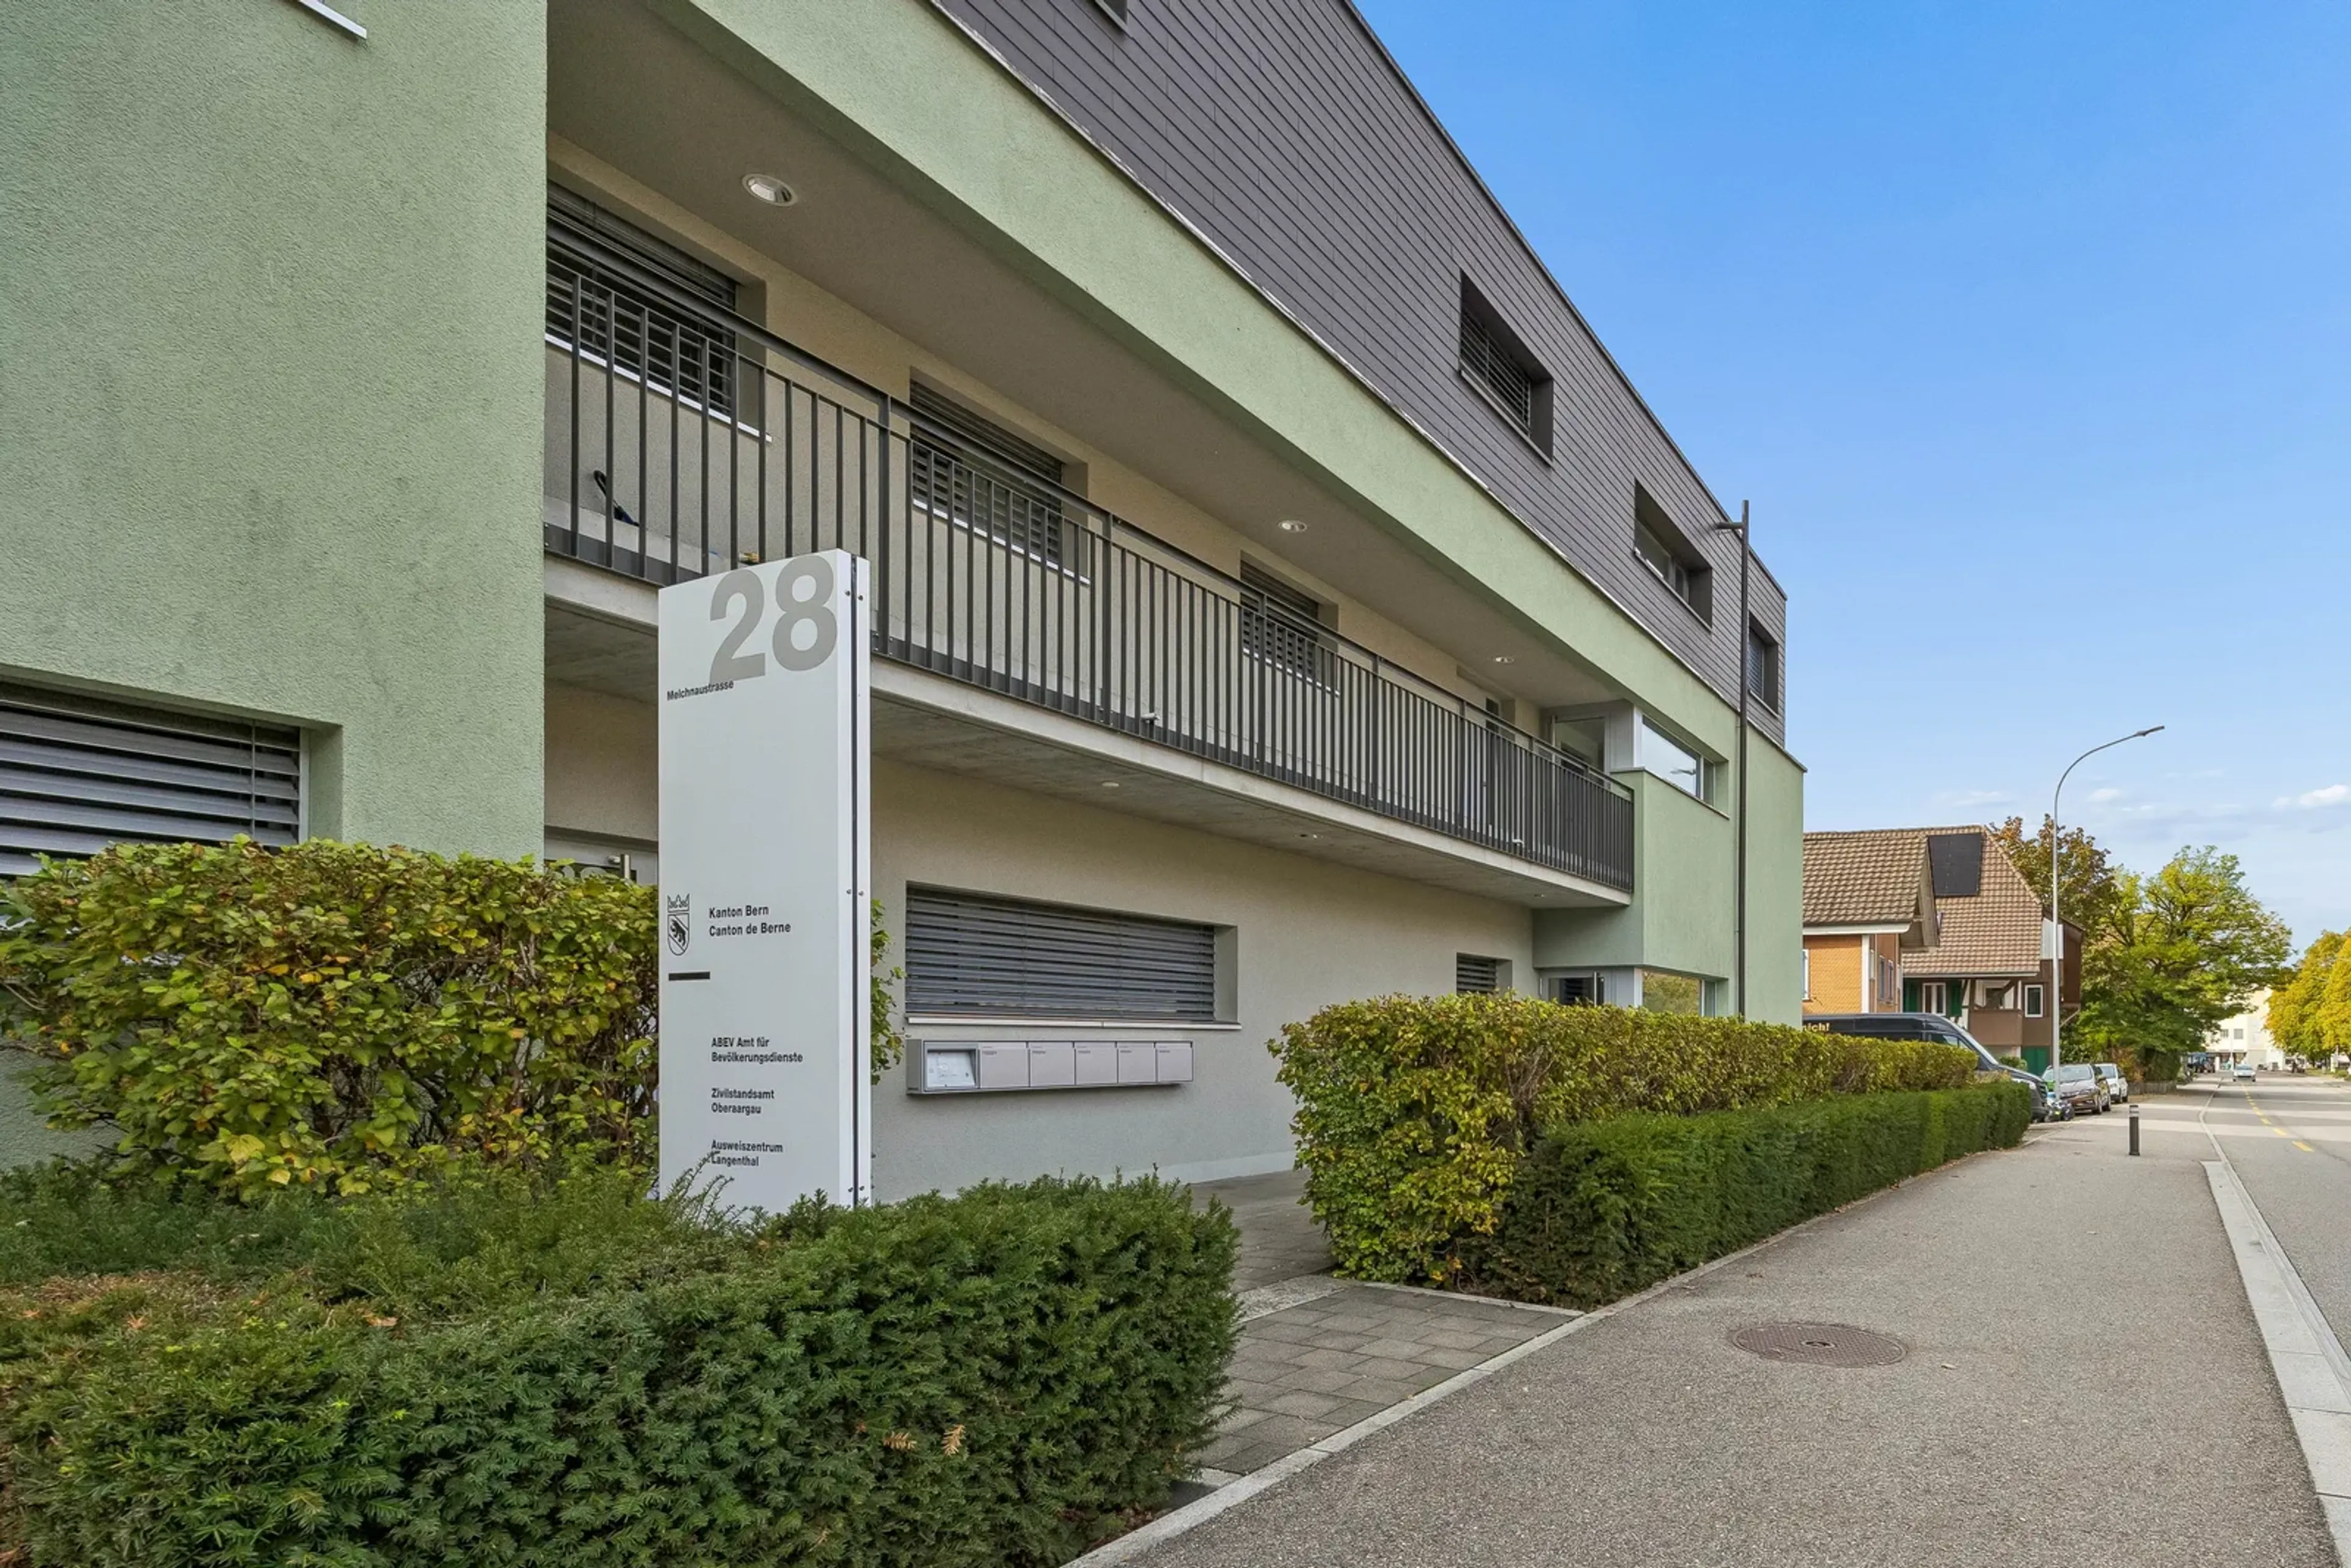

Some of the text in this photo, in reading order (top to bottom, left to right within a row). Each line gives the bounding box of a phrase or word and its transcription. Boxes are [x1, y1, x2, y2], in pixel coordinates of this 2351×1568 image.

[710, 555, 838, 684] 28
[667, 680, 734, 701] Melchnaustrasse
[709, 905, 769, 918] Kanton Bern
[709, 922, 791, 937] Canton de Berne
[711, 1037, 770, 1047] ABEV Amt für
[711, 1051, 803, 1065] Bevölkerungsdienste
[711, 1087, 774, 1100] Zivilstandsamt
[711, 1102, 762, 1116] Oberaargau
[711, 1139, 783, 1152] Ausweiszentrum
[711, 1155, 759, 1167] Langenthal
